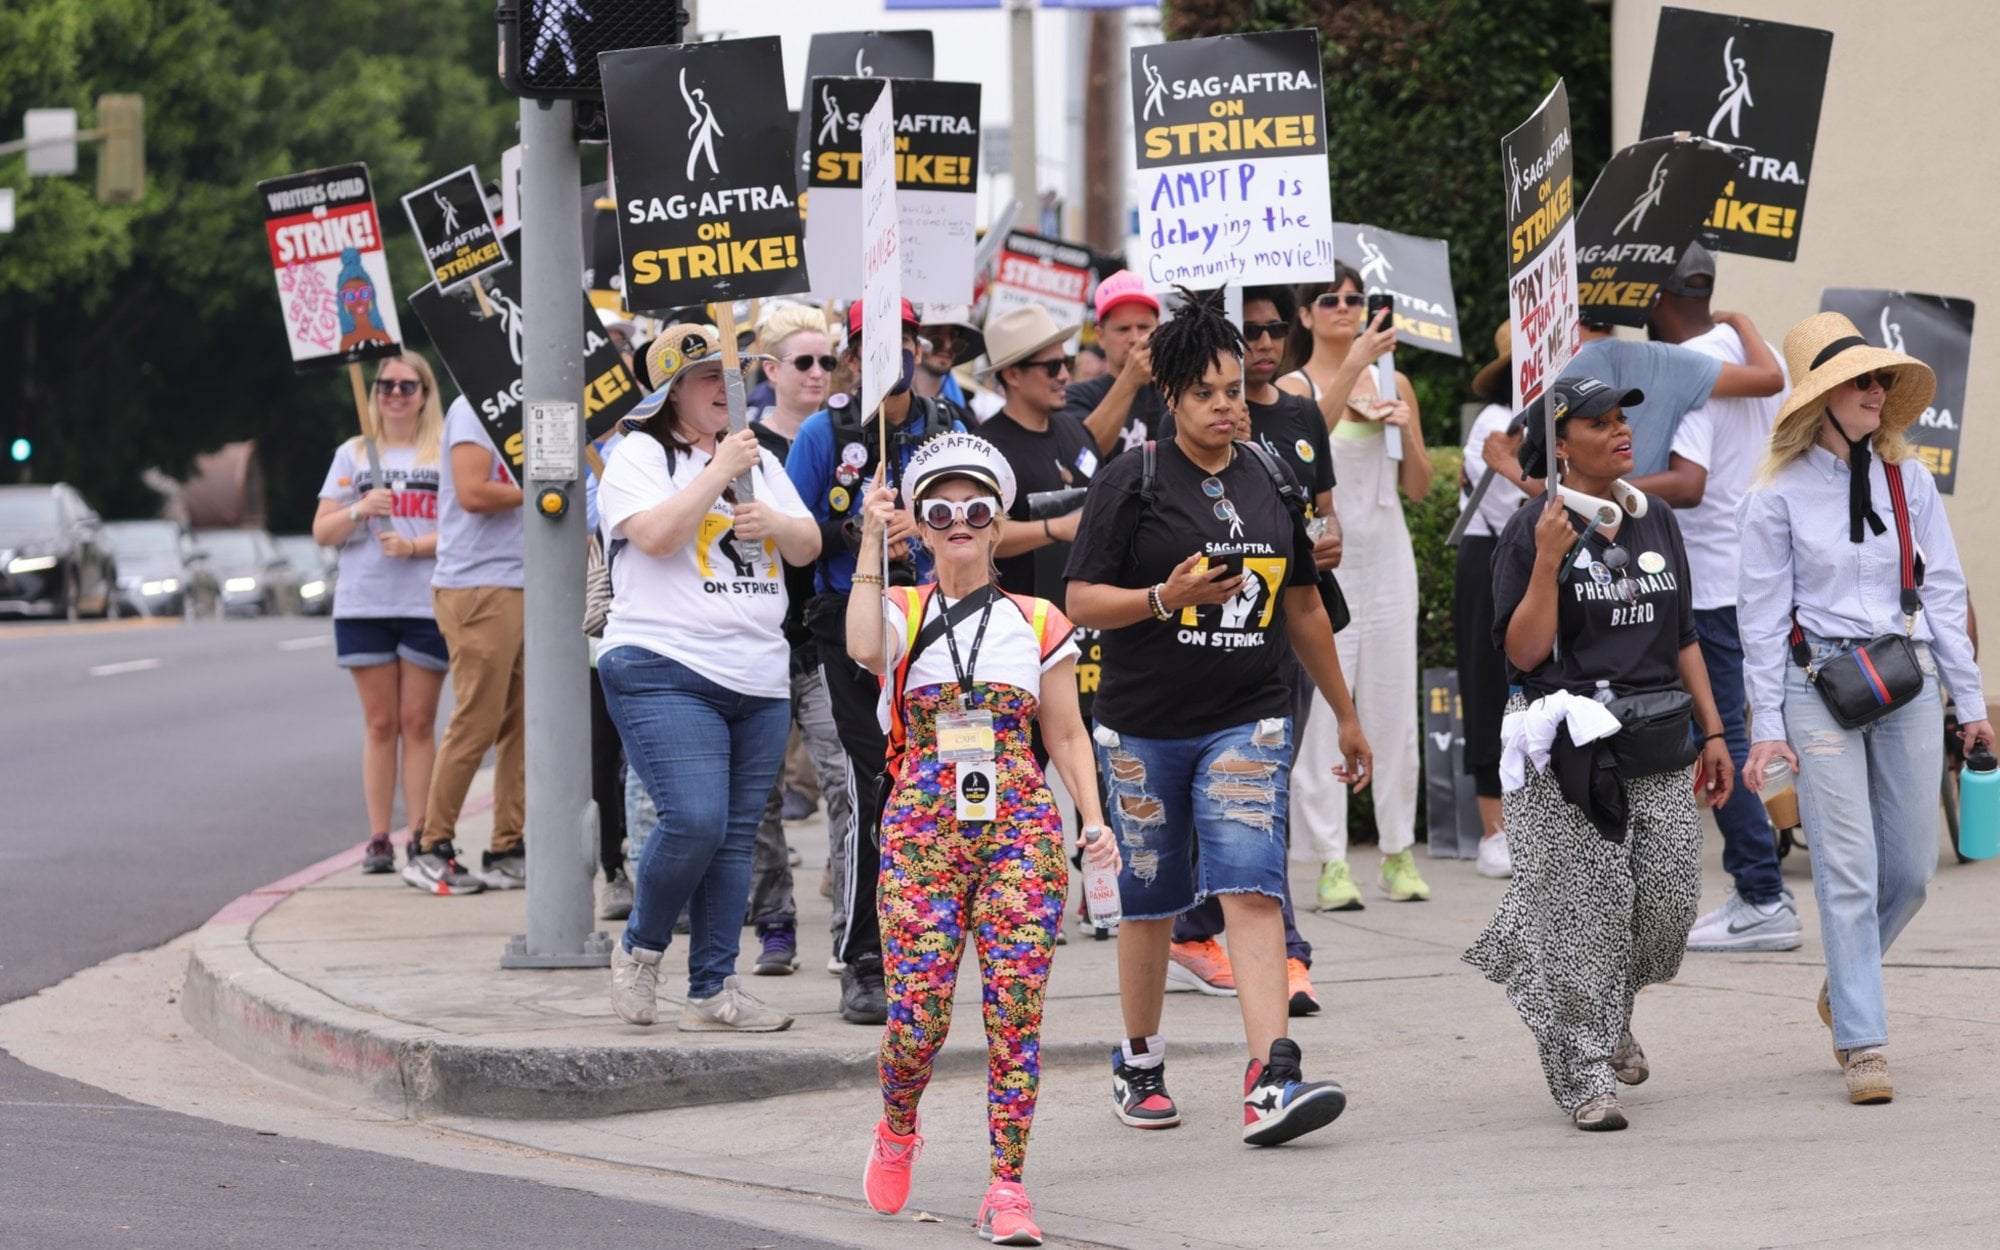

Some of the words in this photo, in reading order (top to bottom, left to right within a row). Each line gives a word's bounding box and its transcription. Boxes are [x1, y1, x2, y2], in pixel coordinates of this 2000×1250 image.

[1209, 99, 1244, 118] ON
[1144, 114, 1317, 159] STRIKE!
[816, 151, 971, 185] STIKE!
[267, 184, 327, 213] WRITERS
[327, 177, 366, 201] GUILD
[1278, 169, 1303, 197] is
[1538, 177, 1551, 202] ON
[697, 221, 731, 241] ON
[1262, 206, 1310, 232] the
[1511, 174, 1572, 264] STRIKE!
[275, 210, 376, 263] STRIKE!
[434, 242, 501, 282] STRIKE!
[456, 244, 471, 257] ON
[632, 235, 799, 284] STRIKE!
[1149, 251, 1246, 283] Community
[1254, 239, 1332, 268] movie!!!
[1591, 266, 1617, 280] ON
[1578, 282, 1661, 308] RIKE!
[1526, 291, 1557, 348] WHAT
[1520, 344, 1544, 395] OWE
[704, 581, 728, 593] ON
[733, 581, 779, 594] STRIKE!
[1611, 602, 1655, 627] BLERD
[1177, 629, 1206, 646] ON
[1089, 889, 1115, 900] PANNA
